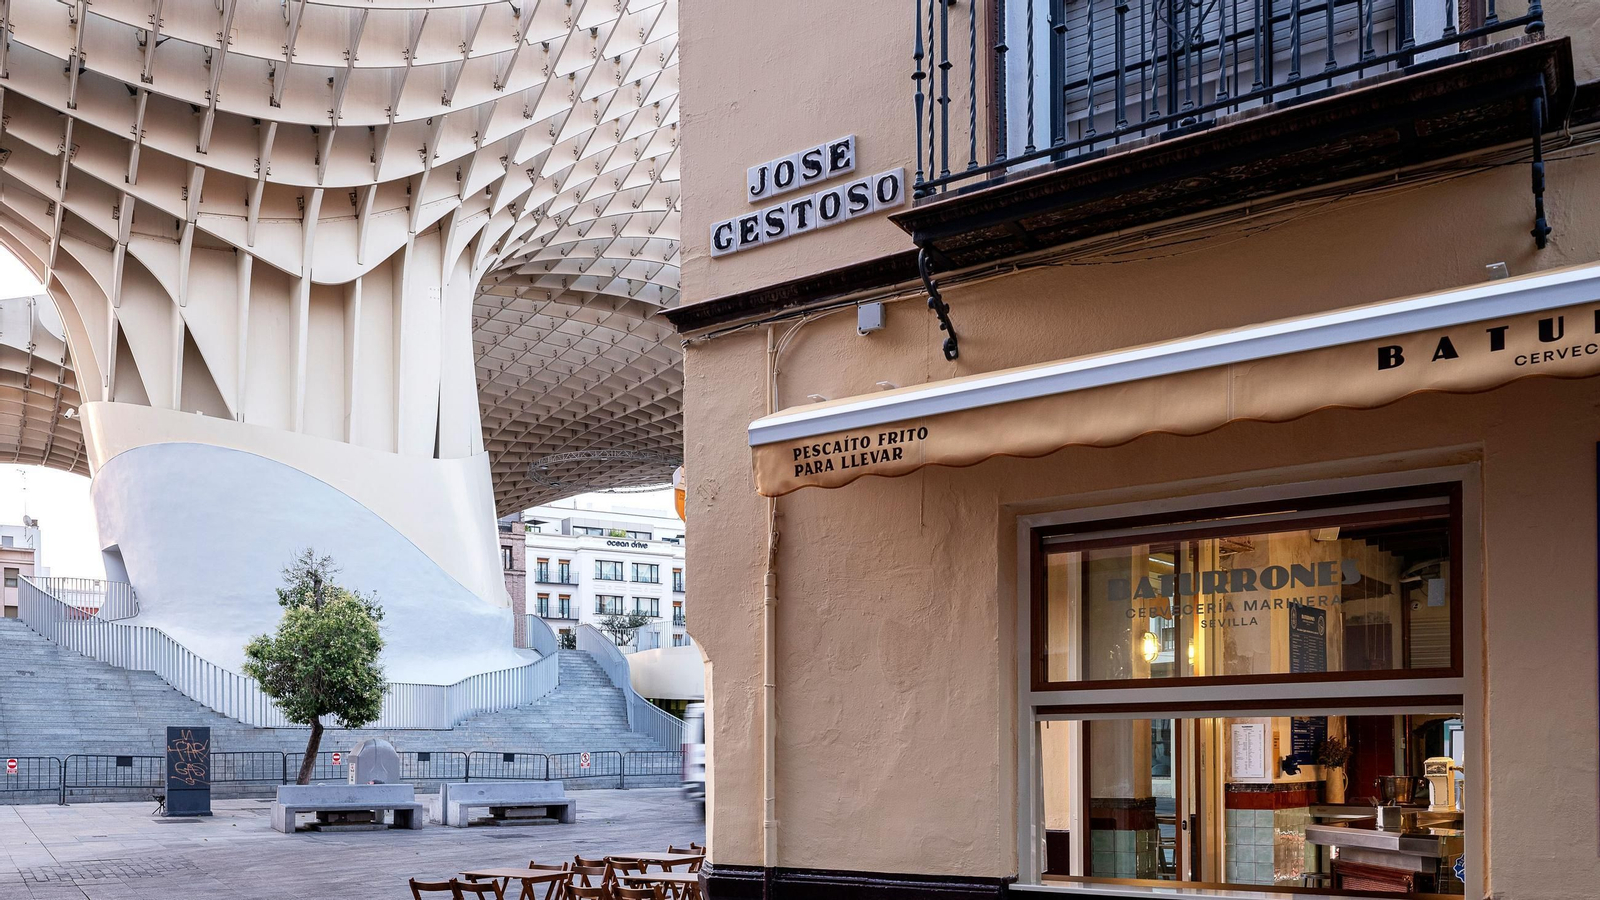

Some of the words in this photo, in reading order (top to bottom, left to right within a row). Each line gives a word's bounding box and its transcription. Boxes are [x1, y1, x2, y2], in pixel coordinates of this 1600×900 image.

[750, 138, 851, 196] JOSE
[712, 174, 899, 250] GESTOSO
[1377, 309, 1600, 371] BATU
[1514, 343, 1599, 366] CERVEC
[793, 436, 870, 460] PESCAÍTO
[878, 426, 929, 446] FRITO
[794, 460, 834, 477] PARA
[841, 447, 903, 470] LLEVAR
[631, 540, 648, 549] drive
[1108, 558, 1362, 600] BATURRONES
[1125, 598, 1235, 619] CERVECERÍA
[1243, 594, 1342, 612] MARINERA
[1200, 616, 1258, 629] SEVILLA
